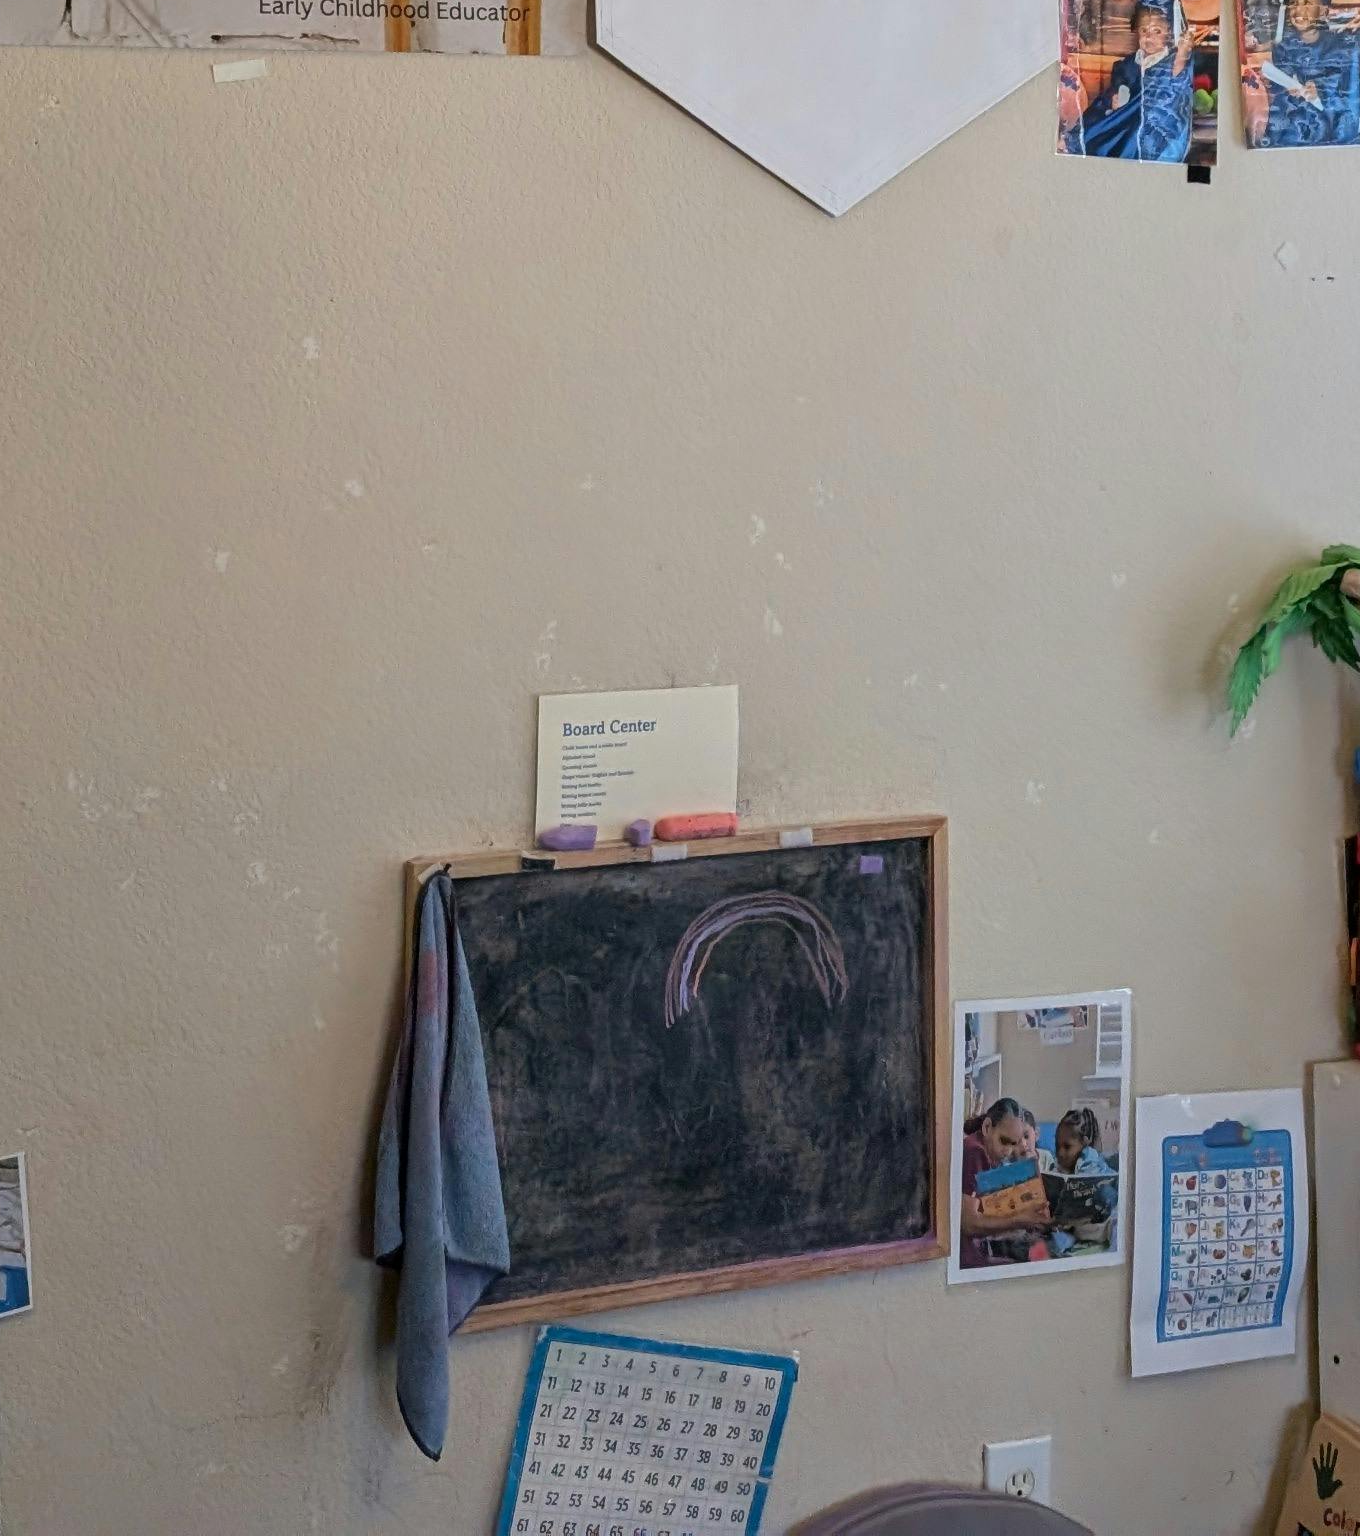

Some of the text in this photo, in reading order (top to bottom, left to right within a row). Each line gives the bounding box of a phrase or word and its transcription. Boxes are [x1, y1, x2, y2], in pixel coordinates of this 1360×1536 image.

[437, 2, 530, 21] Educator
[562, 719, 657, 737] Board Center
[556, 1348, 776, 1391] 1 2 3 4 5 6 7 8 9 10
[547, 1376, 771, 1417] 11 12 13 14 15 16 17 18 19 20
[539, 1403, 764, 1443] 21 22 23 24 25 26 27 28 29 30
[533, 1431, 758, 1470] 31 32 33 34 35 36 37 38 39 40
